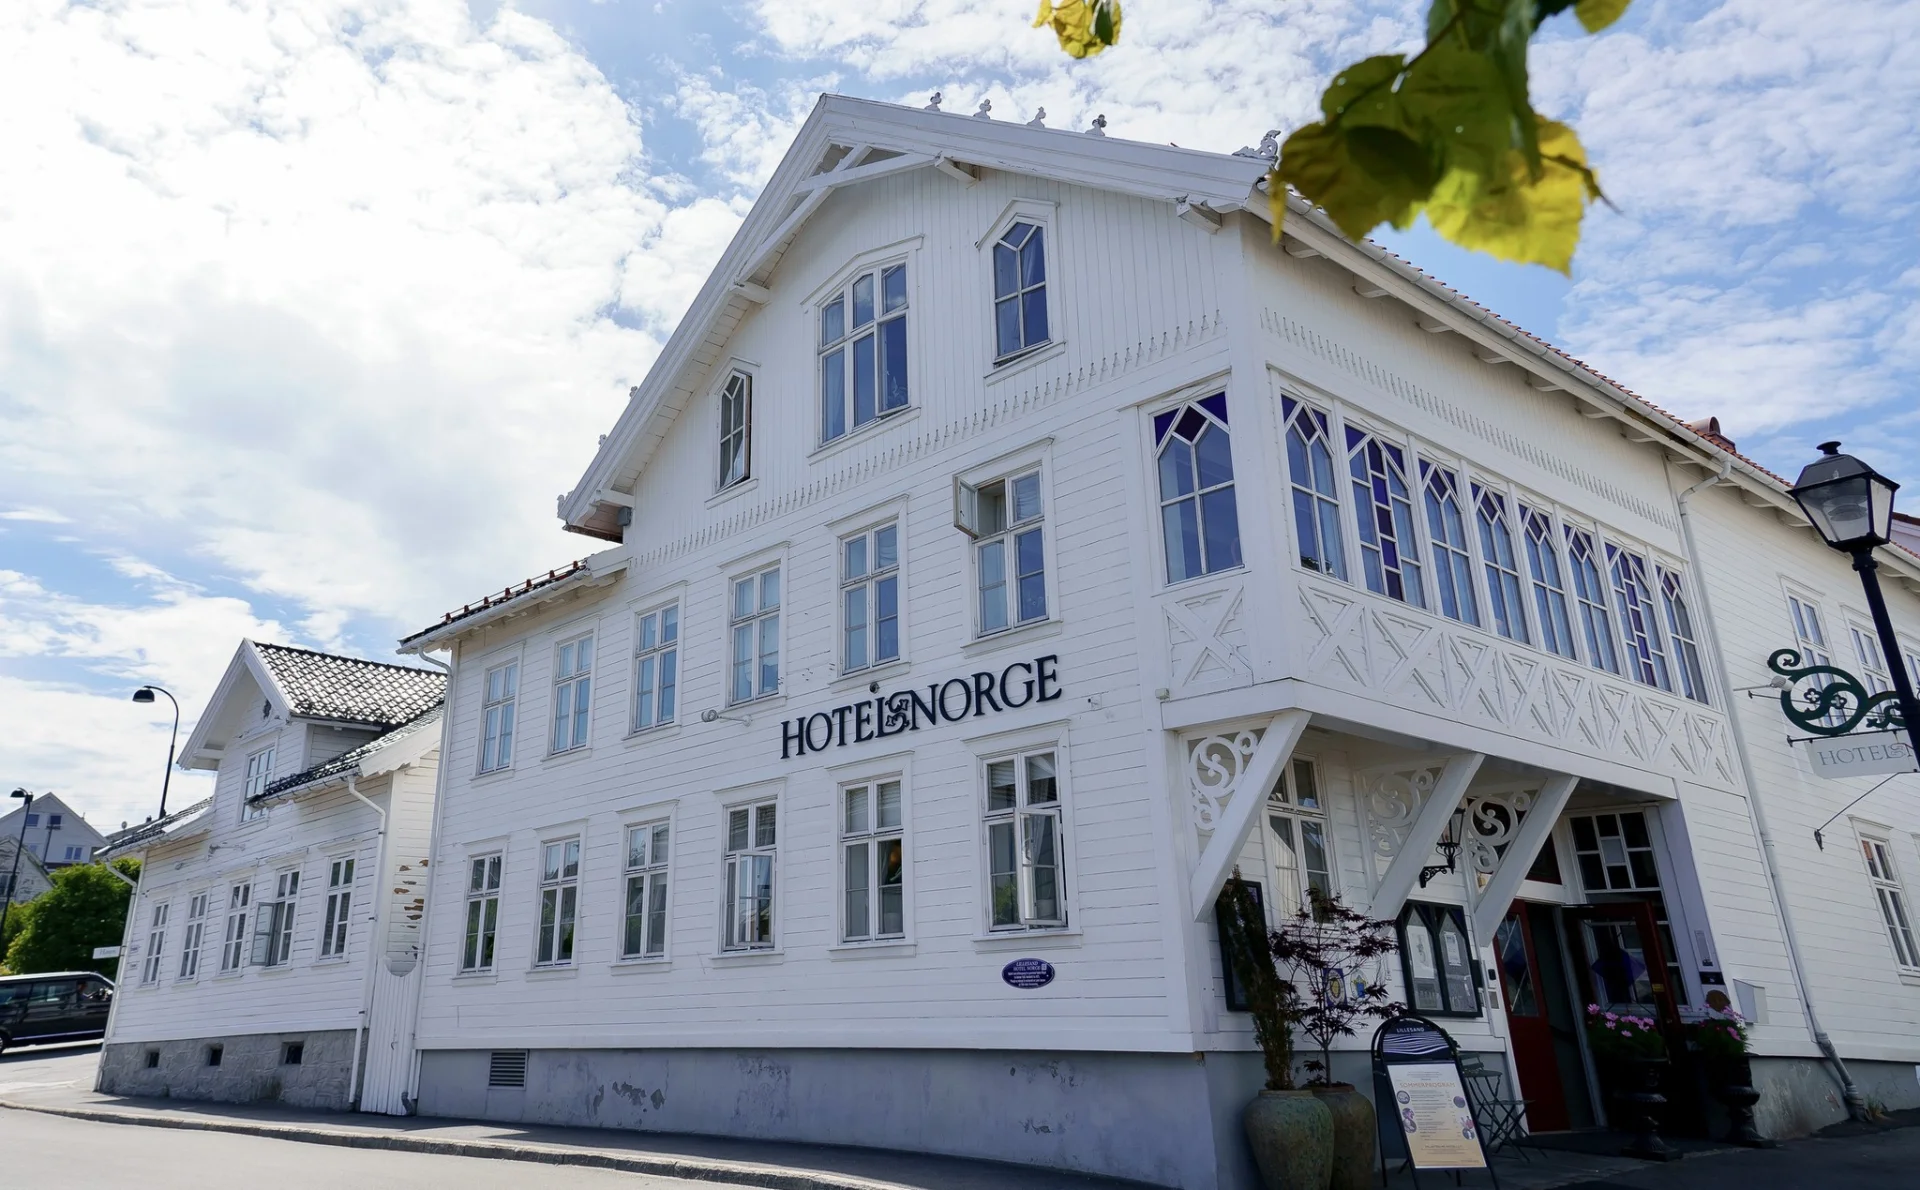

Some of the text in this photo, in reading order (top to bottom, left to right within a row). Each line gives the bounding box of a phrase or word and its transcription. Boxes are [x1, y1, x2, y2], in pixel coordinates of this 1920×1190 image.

[780, 654, 1062, 759] HOTEL NORGE
[1817, 744, 1904, 765] HOTEL
